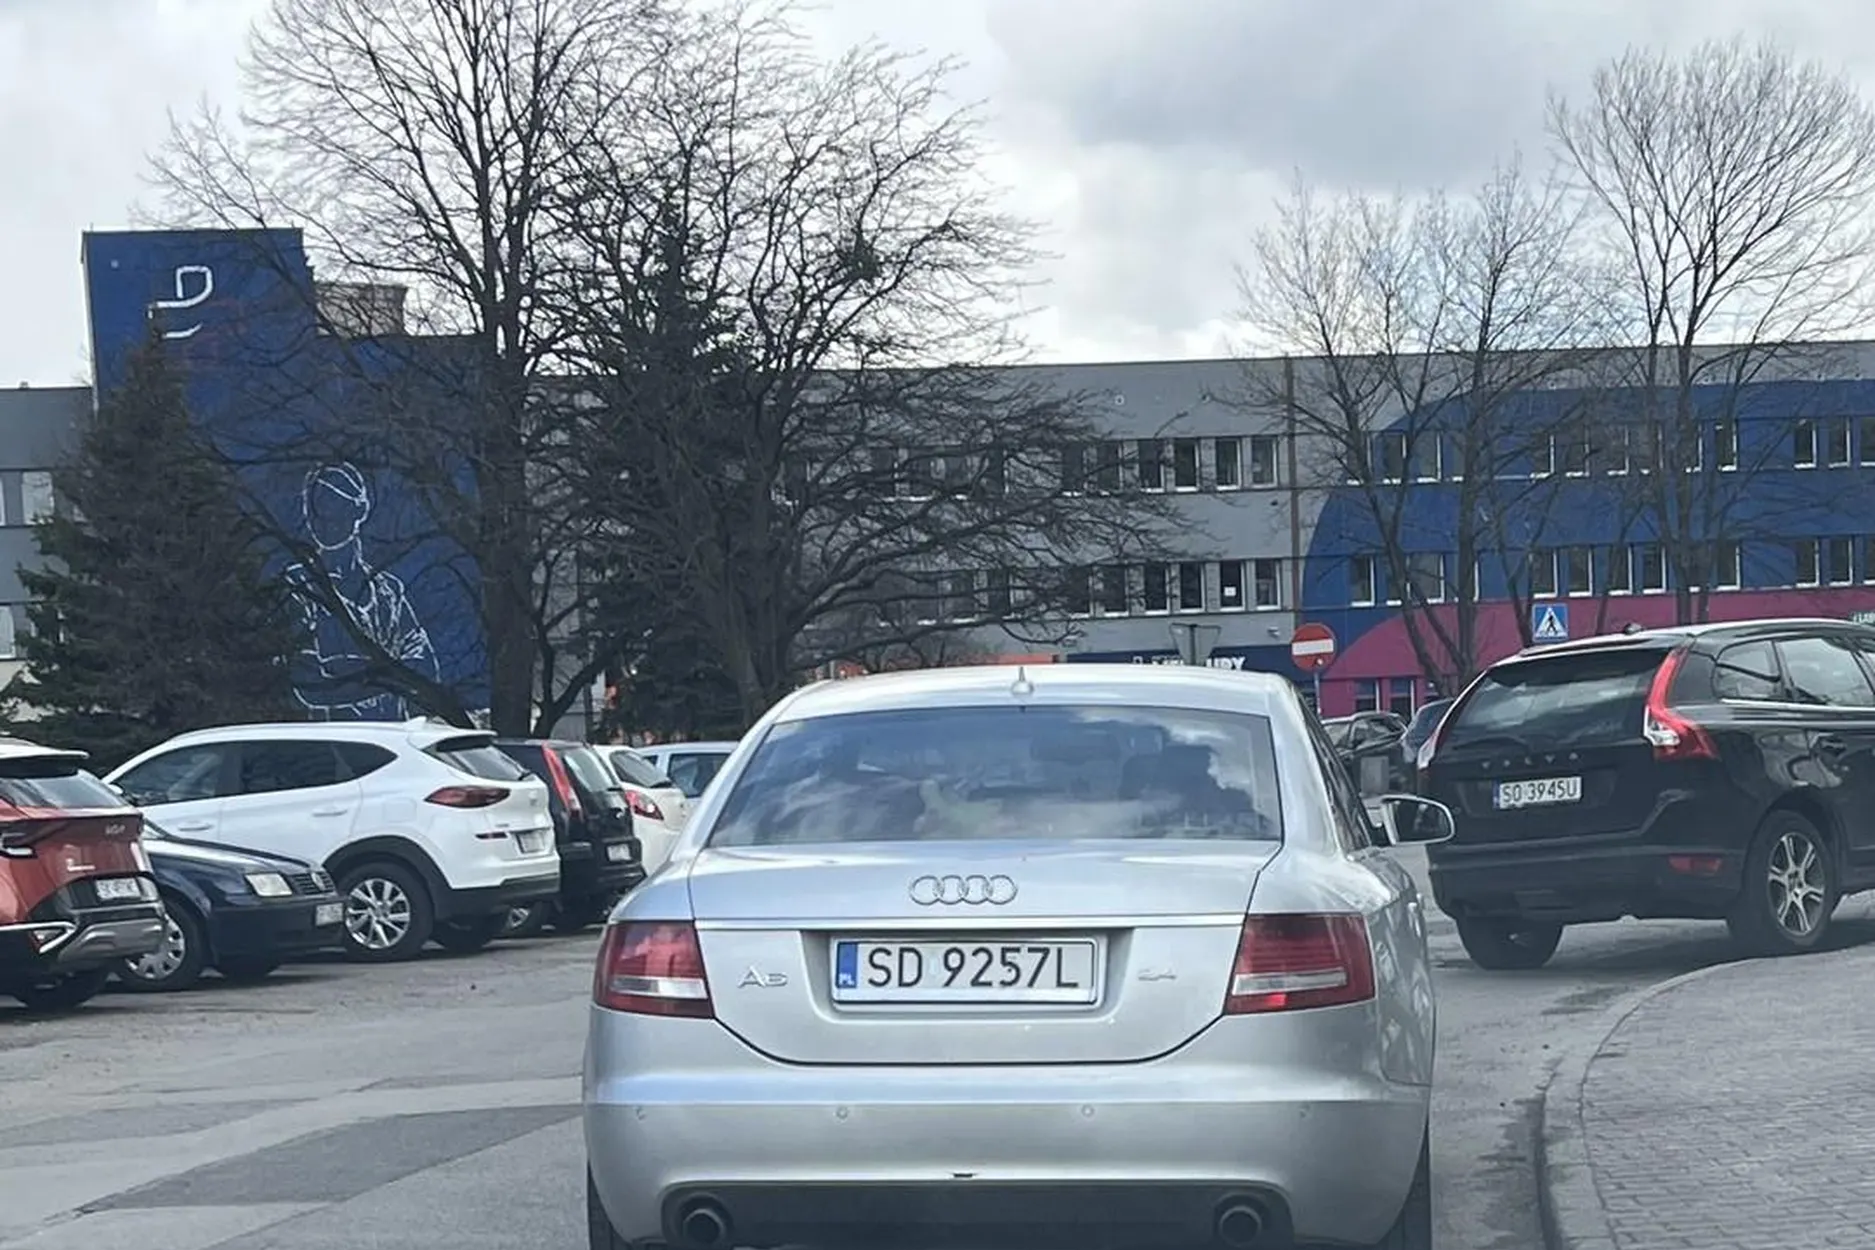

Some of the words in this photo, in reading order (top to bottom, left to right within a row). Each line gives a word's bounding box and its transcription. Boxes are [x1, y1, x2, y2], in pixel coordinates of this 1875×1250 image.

[737, 965, 787, 988] A6
[868, 947, 923, 988] SD
[943, 946, 1079, 989] 9257L
